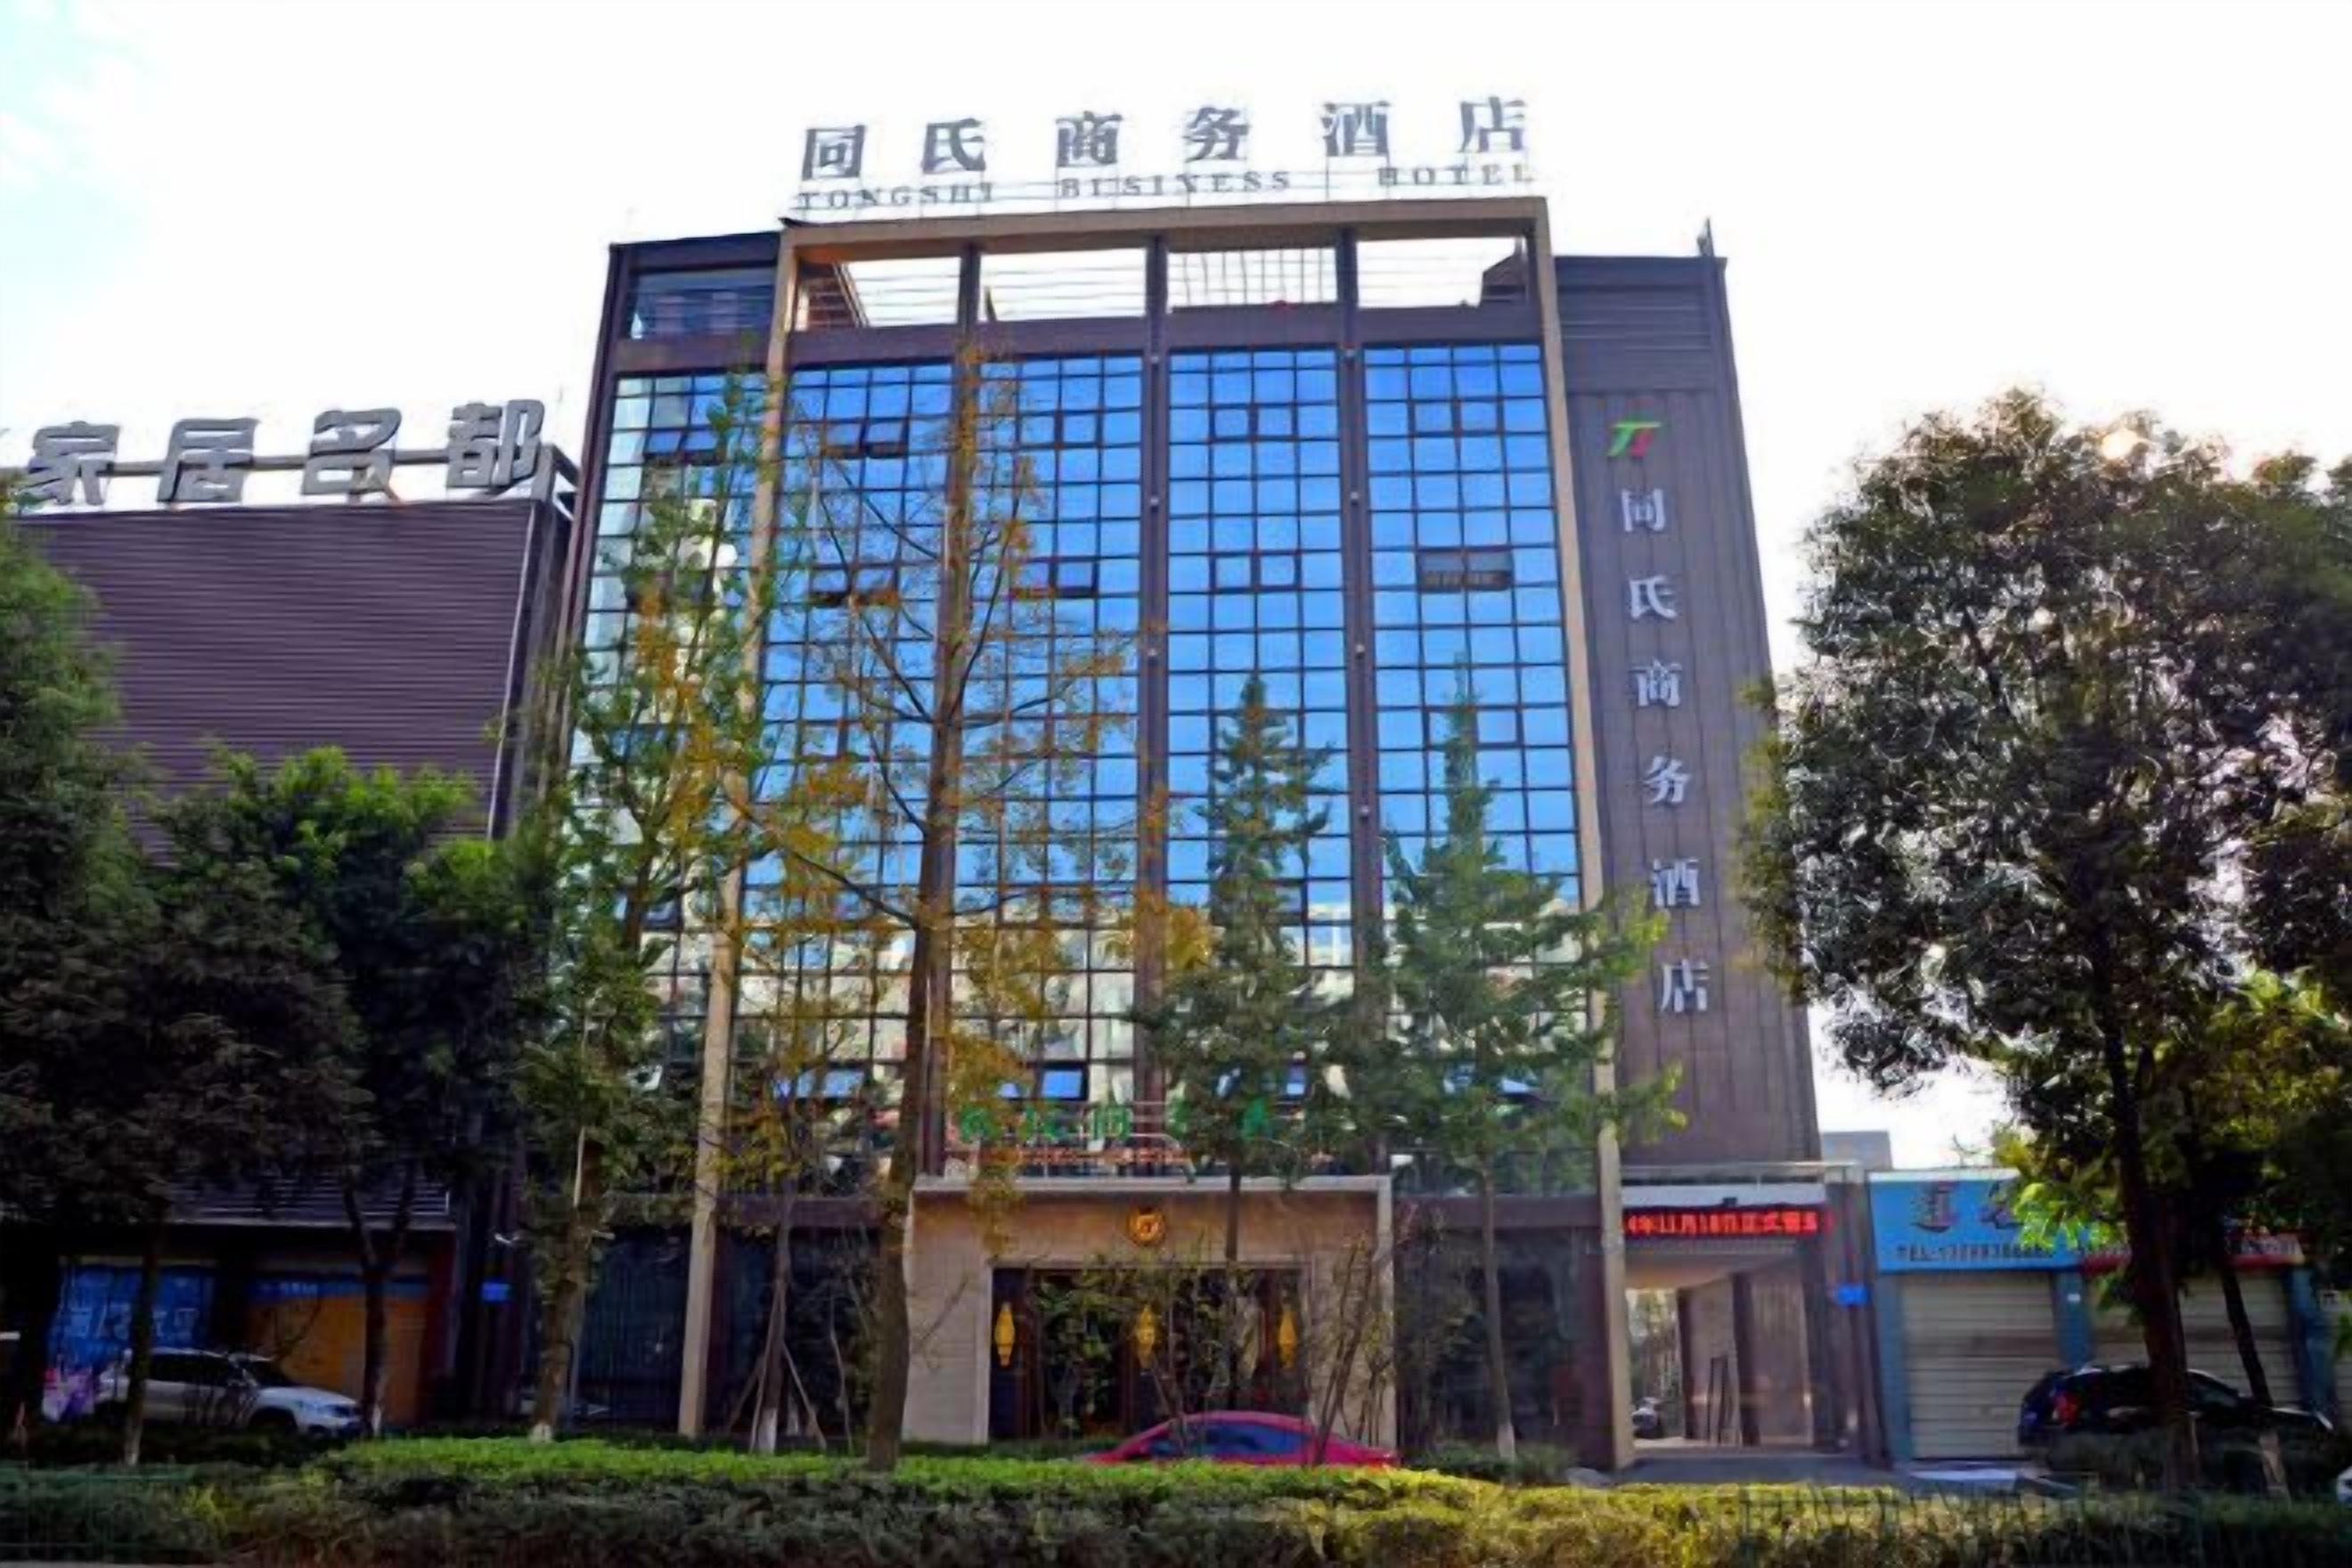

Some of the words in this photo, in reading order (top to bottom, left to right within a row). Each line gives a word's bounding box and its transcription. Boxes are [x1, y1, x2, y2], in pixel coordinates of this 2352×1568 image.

[796, 182, 994, 209] TONGSHI
[1059, 170, 1291, 199] BUSINESS
[1378, 164, 1532, 186] HOTEL
